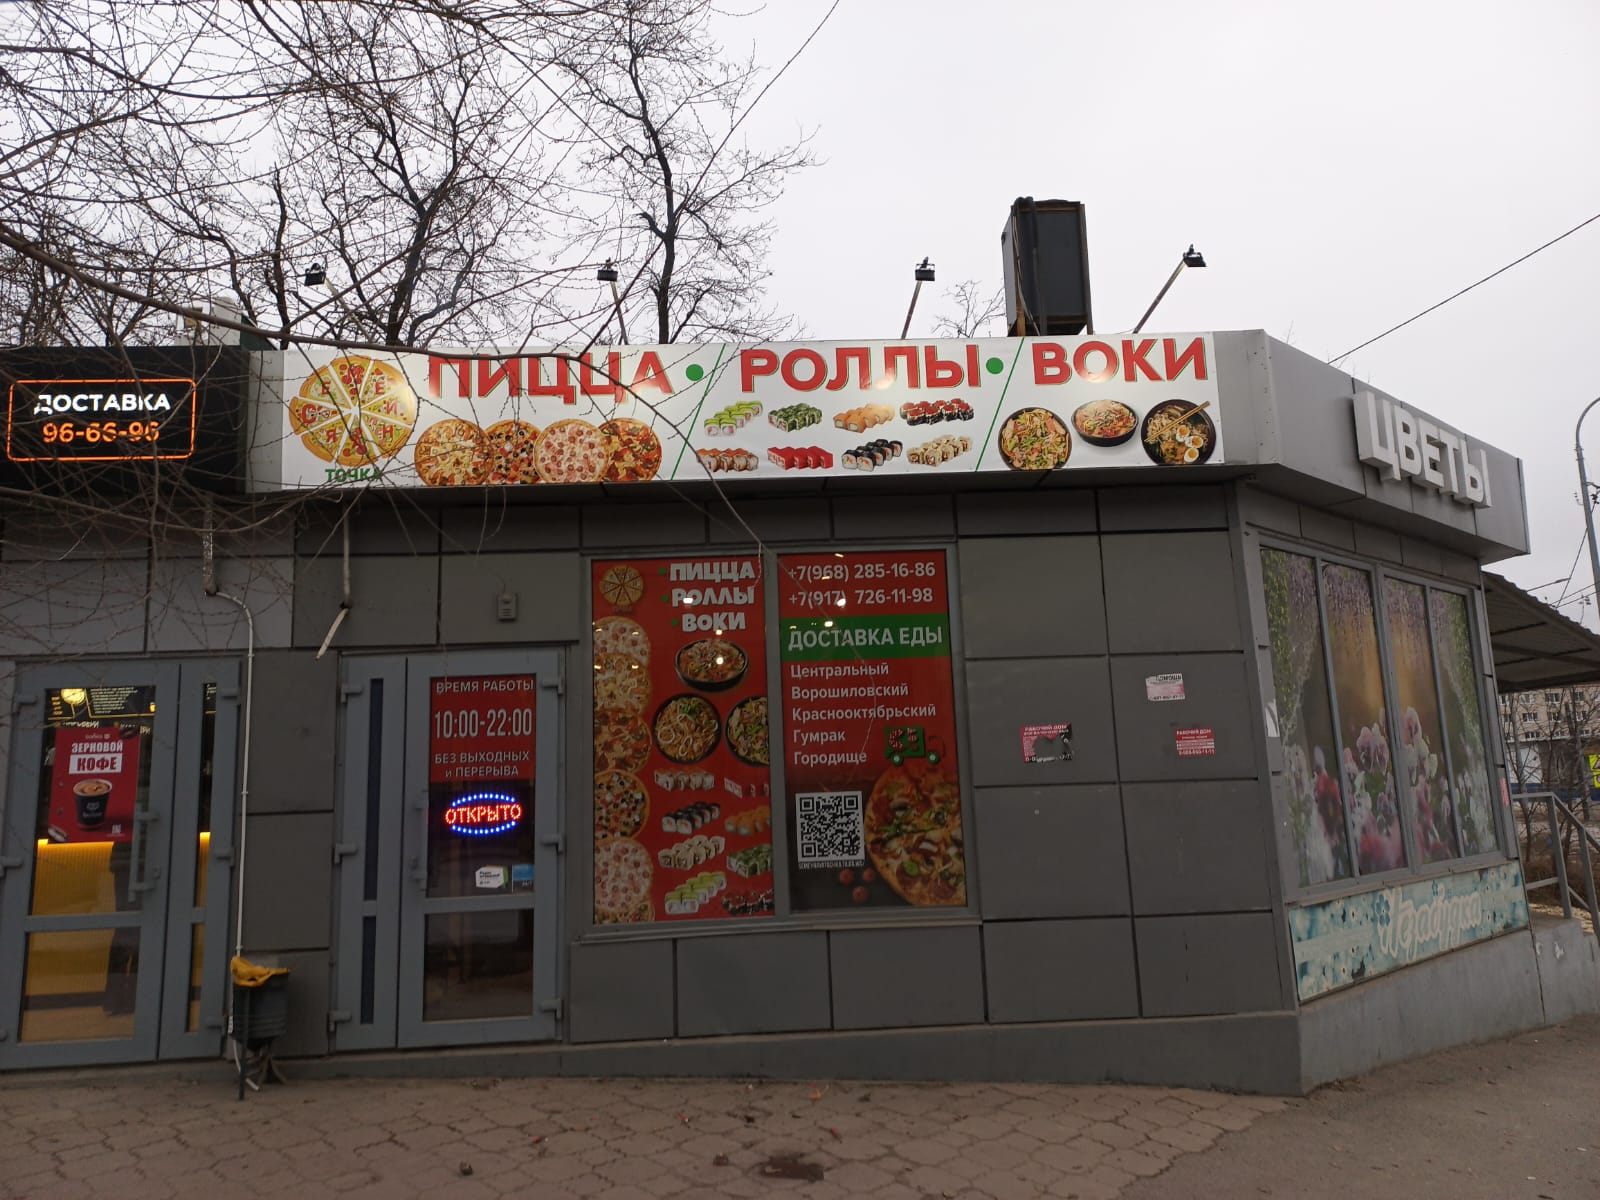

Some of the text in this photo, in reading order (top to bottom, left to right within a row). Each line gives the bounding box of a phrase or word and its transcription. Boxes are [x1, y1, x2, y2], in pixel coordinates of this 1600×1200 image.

[428, 336, 1209, 405] ПИЦЦА РОЛЛЫ ВОКИ
[33, 393, 171, 415] ДОСТАВКА
[42, 421, 160, 443] 96-66-96
[1353, 390, 1492, 509] ЦВЕТЫ
[325, 467, 381, 484] ТОЧКА
[670, 561, 755, 583] ПИЦЦА
[788, 561, 936, 583] +7(968) 285-16-86
[671, 586, 755, 607] РОЛЛЫ
[855, 587, 934, 605] 726-11-98
[682, 612, 746, 632] ВОКИ
[788, 626, 943, 651] ДОСТАВКА ЕДЫ
[790, 663, 889, 680] Центральный
[436, 678, 534, 693] ВРЕМЯ РАБОТЫ
[791, 683, 909, 701] Ворошиловский
[434, 708, 533, 738] 10:00-22:00
[792, 704, 936, 723] Краснооктябрьский
[71, 740, 124, 754] ЗЕРНОВОЙ
[793, 729, 846, 746] Гумрак
[76, 756, 117, 772] КОФЕ
[434, 751, 530, 765] БЕЗ ВЫХОДНЫХ
[794, 751, 868, 767] Городище
[455, 765, 519, 777] ПЕРЕРЫВА
[445, 803, 522, 825] ОТКРЫТО
